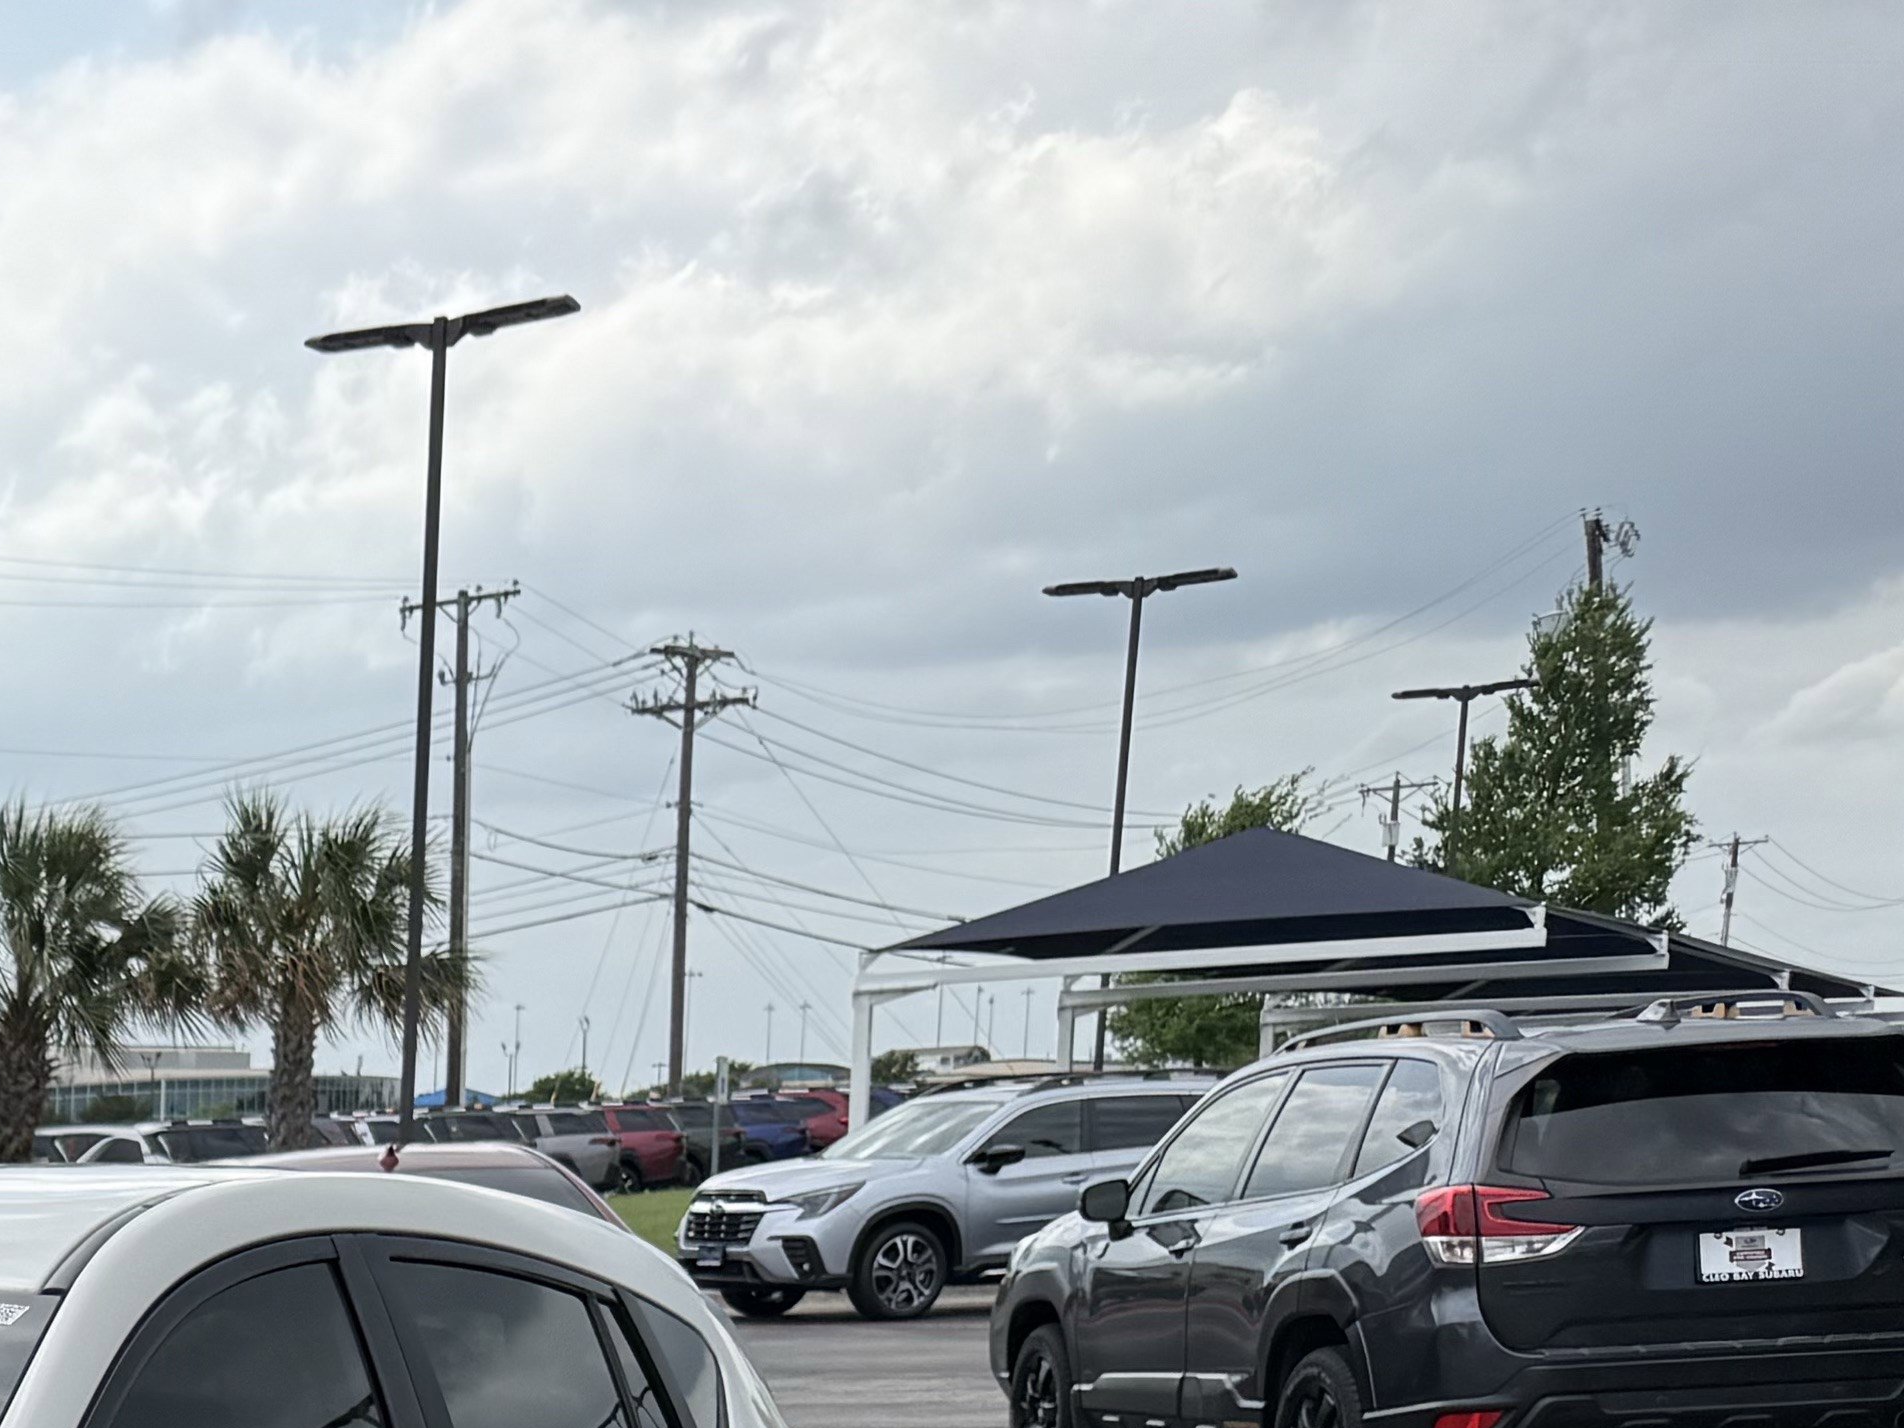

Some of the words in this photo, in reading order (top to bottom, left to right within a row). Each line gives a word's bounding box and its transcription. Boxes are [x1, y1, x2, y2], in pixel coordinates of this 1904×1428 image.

[1702, 1272, 1730, 1282] CLEO
[1733, 1271, 1754, 1281] BAY
[1758, 1269, 1804, 1280] SUBARU
